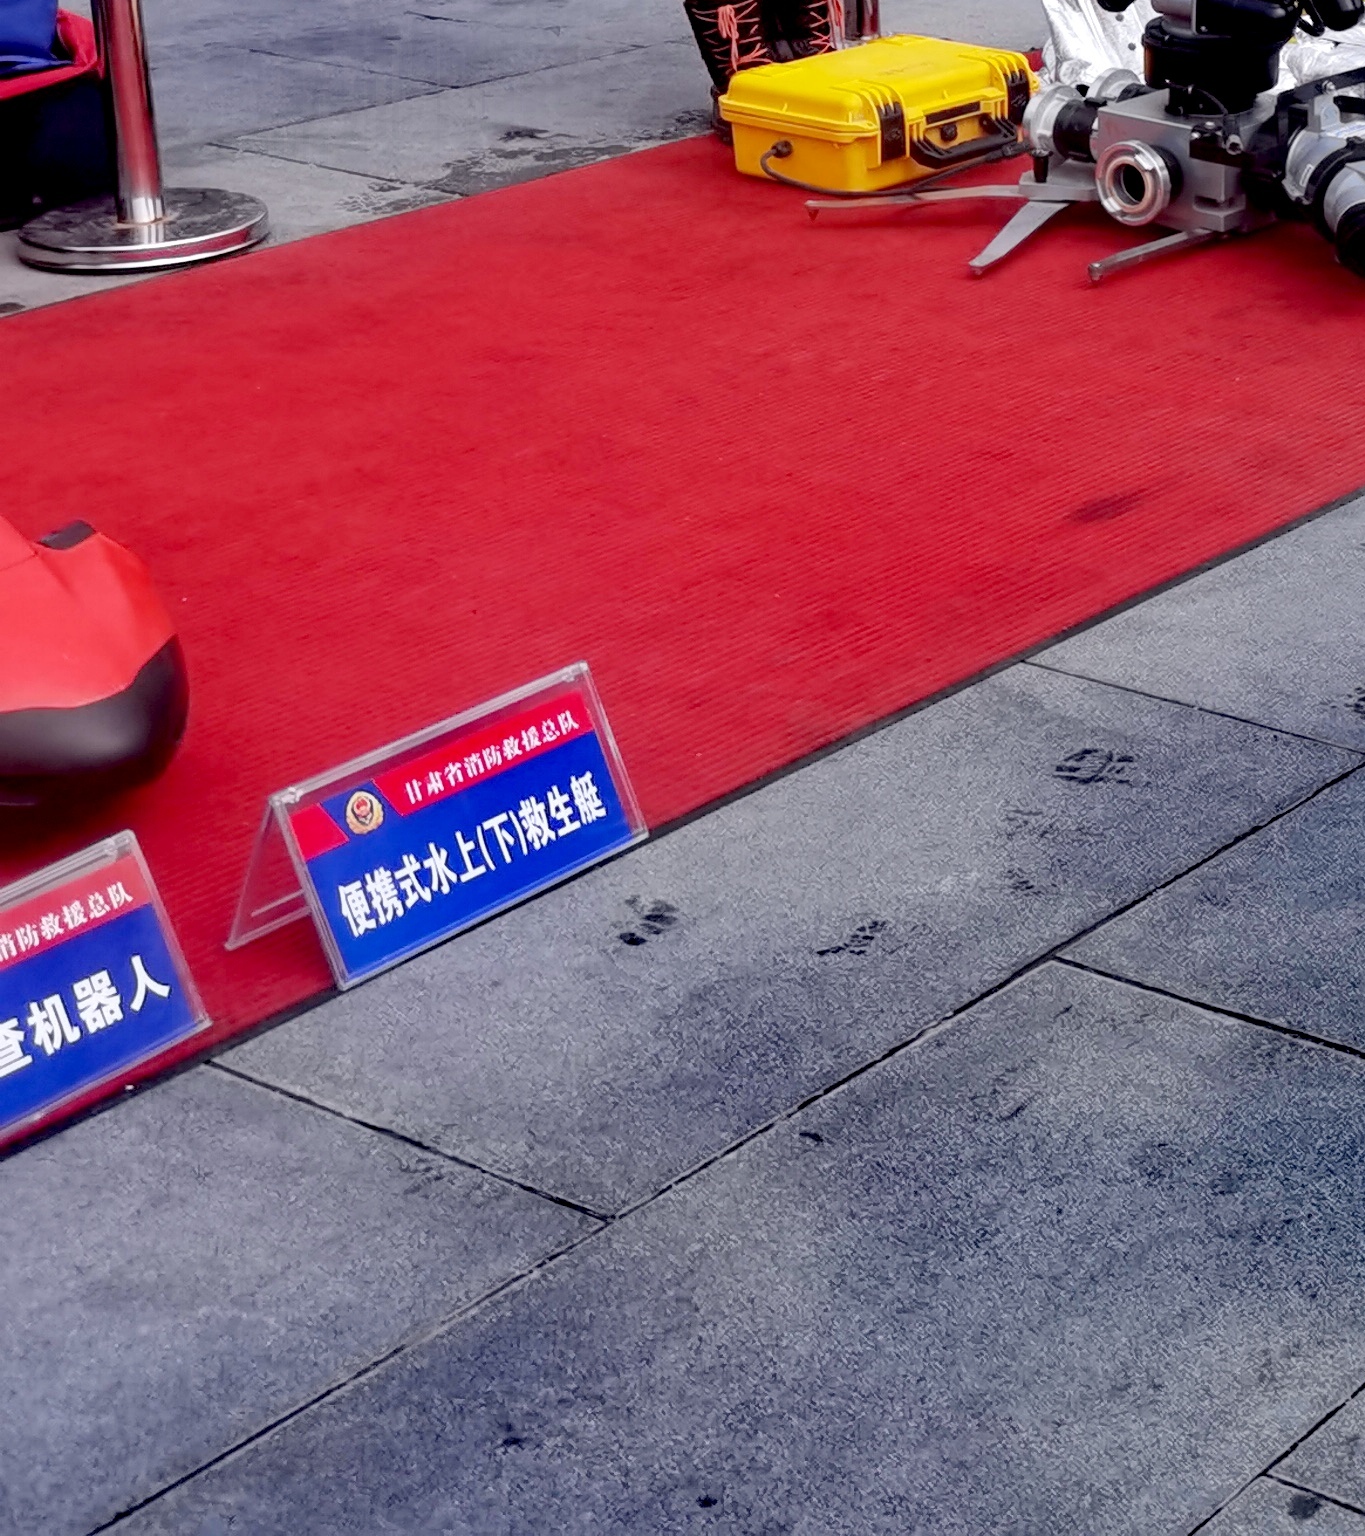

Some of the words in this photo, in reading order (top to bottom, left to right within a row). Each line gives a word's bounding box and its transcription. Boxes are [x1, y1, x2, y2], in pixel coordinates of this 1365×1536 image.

[403, 709, 579, 804] 甘肃省消防救援总队
